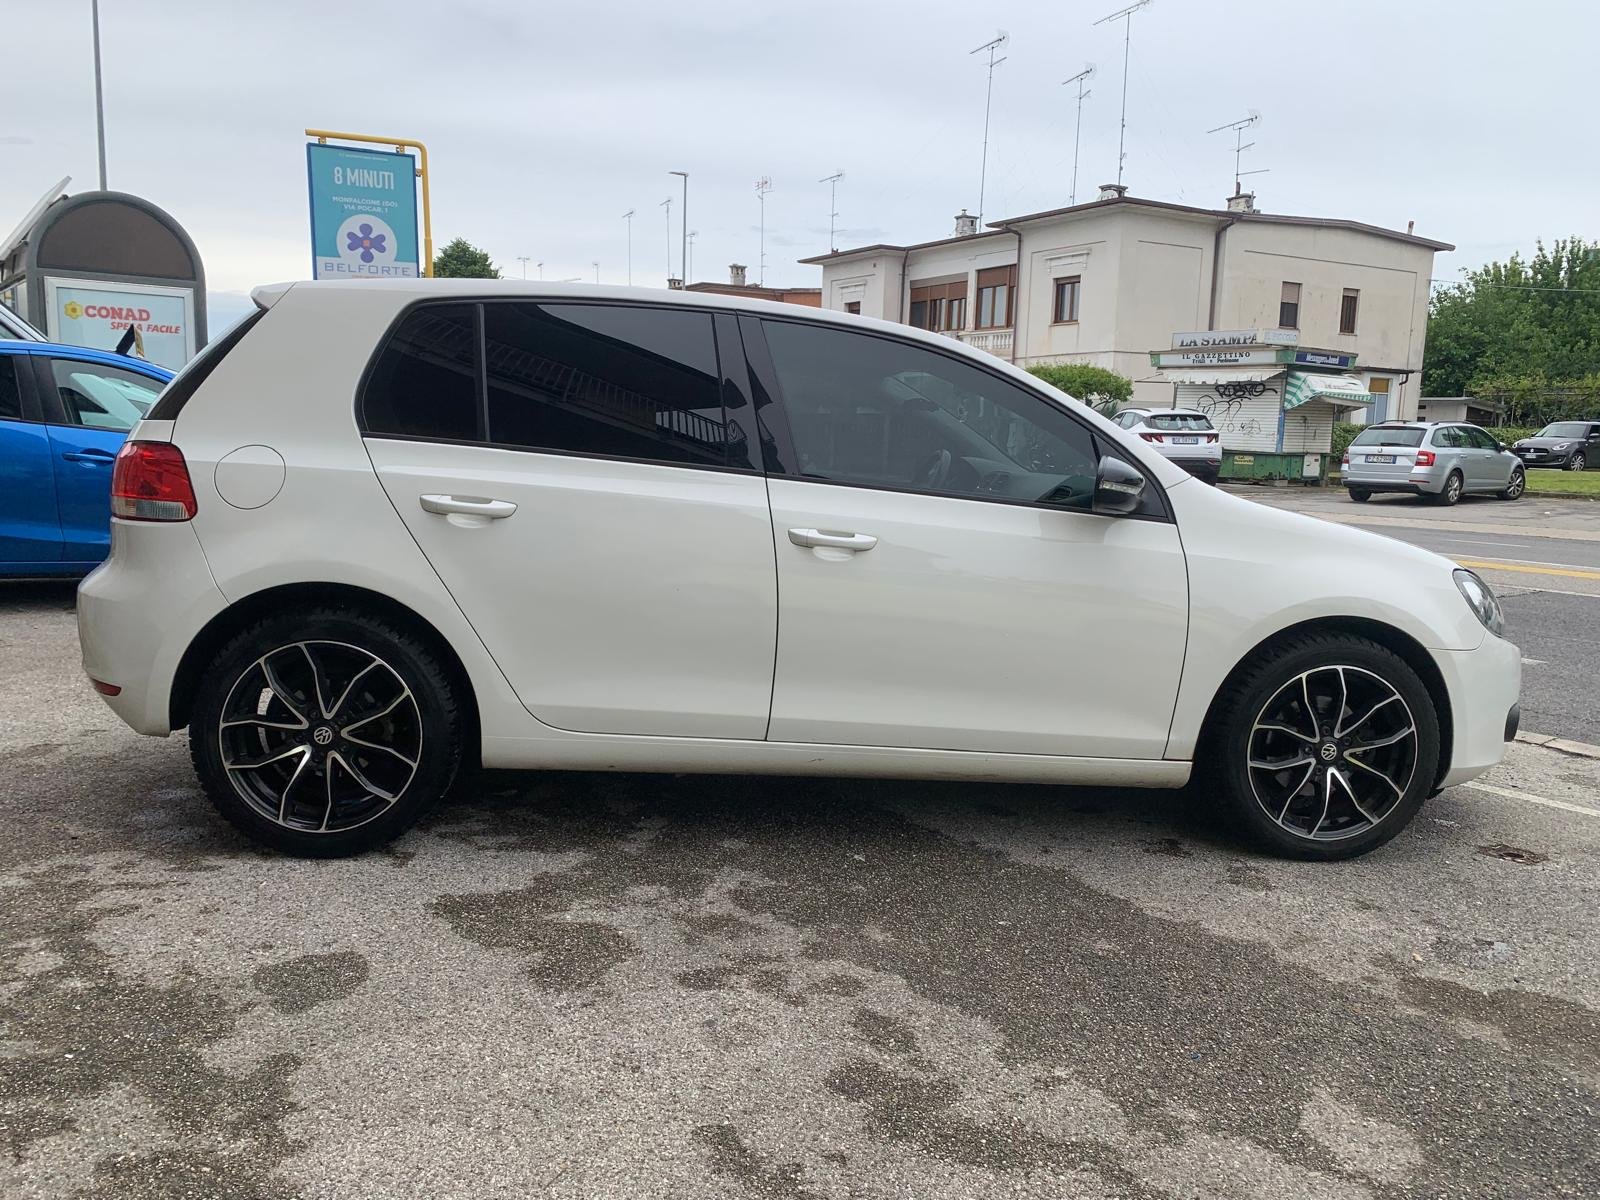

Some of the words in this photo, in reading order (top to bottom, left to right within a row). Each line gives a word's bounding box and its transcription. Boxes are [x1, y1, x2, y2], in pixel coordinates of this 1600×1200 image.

[334, 166, 343, 185] 8
[346, 167, 395, 190] MINUTI
[332, 196, 381, 206] MONFALCONE
[382, 200, 399, 208] (GO)
[324, 262, 411, 276] BELFORTE
[84, 305, 151, 322] CONAD
[110, 321, 143, 331] SPEA
[146, 324, 181, 334] FACILE
[1194, 351, 1251, 360] GAZZETTINO
